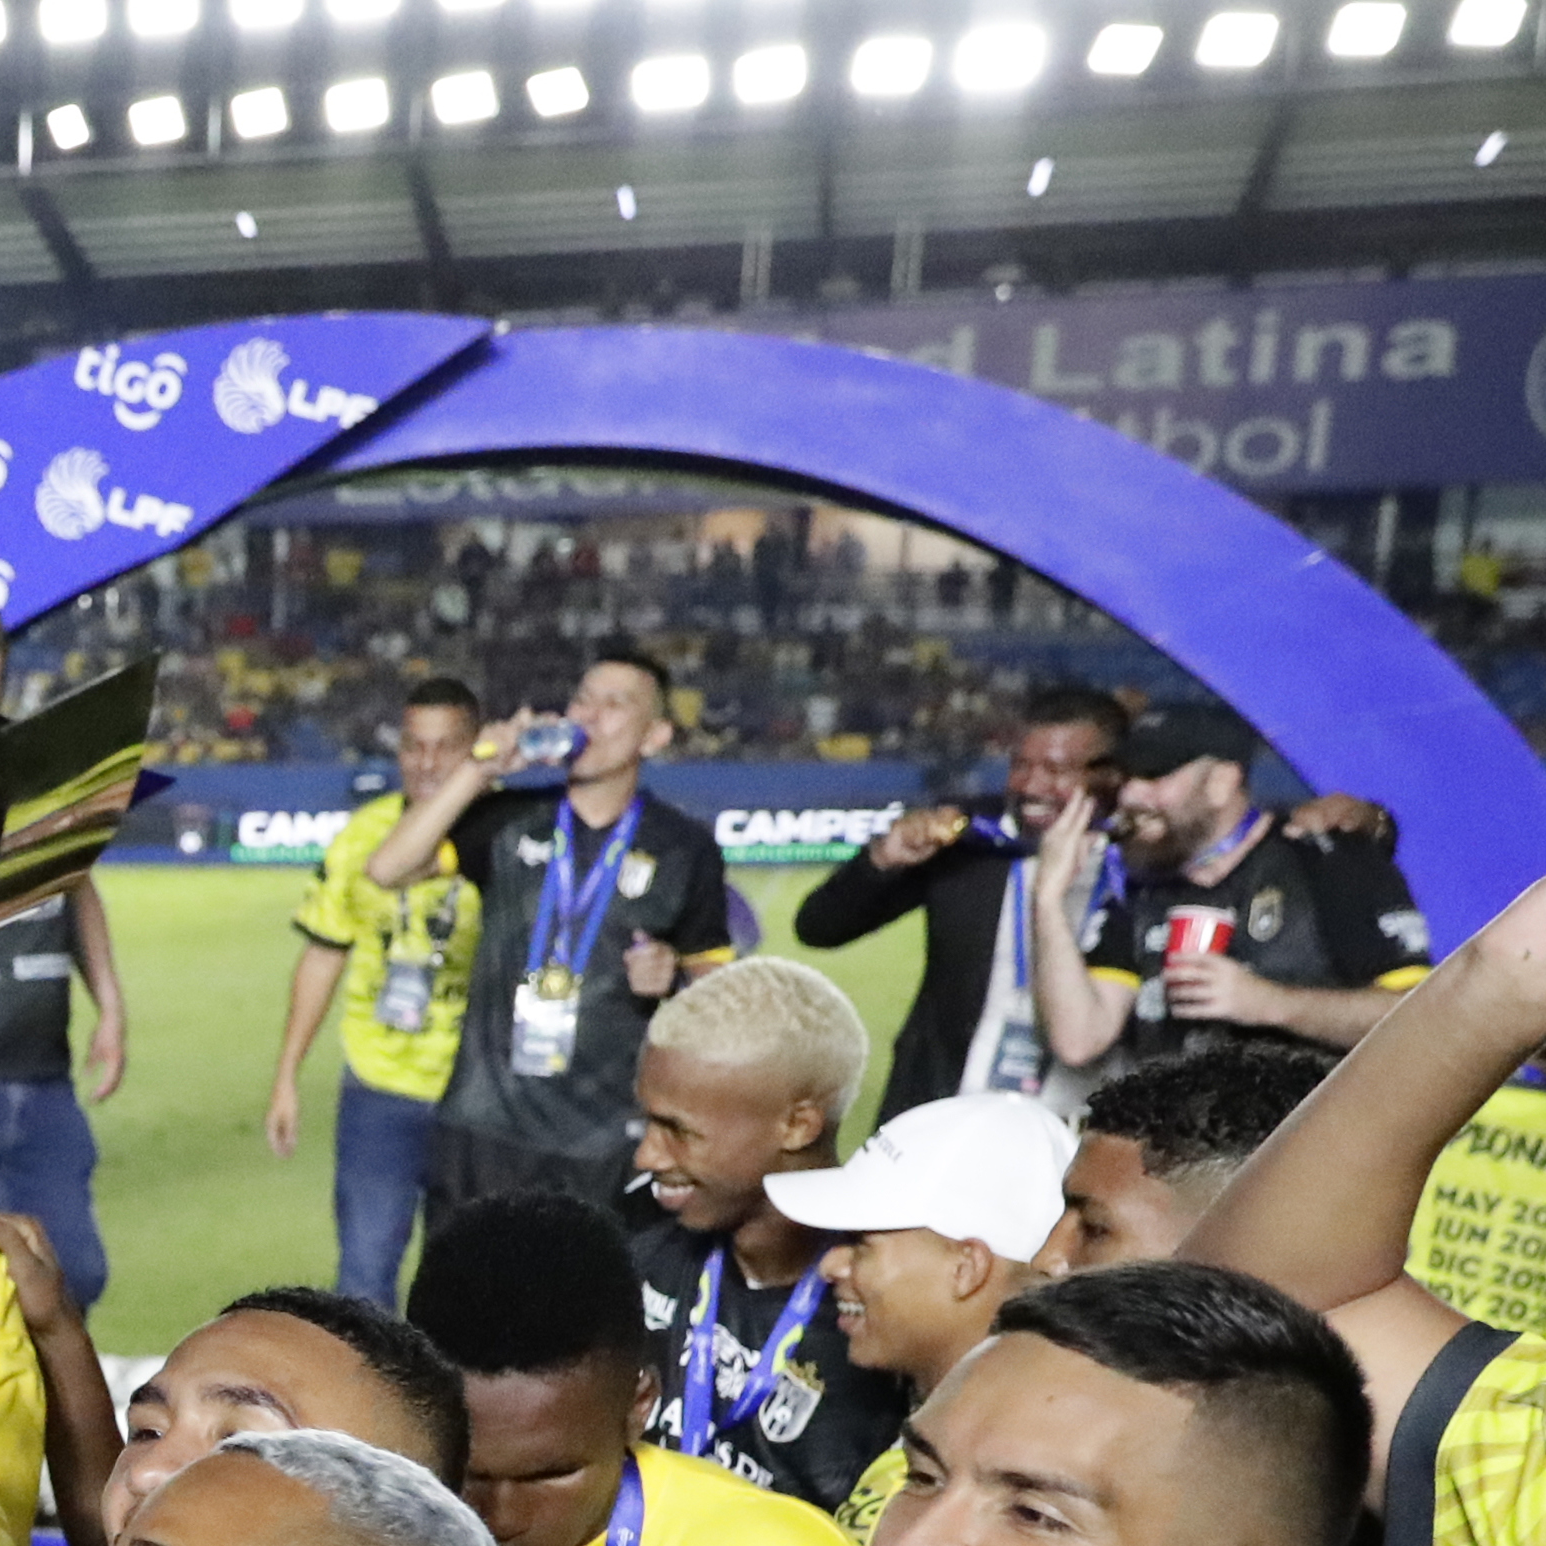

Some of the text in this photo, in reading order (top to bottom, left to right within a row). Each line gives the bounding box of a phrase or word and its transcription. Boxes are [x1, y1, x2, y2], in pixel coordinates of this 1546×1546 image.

[1031, 309, 1459, 396] Latina
[287, 379, 379, 428] LPF
[107, 486, 194, 537] LPF
[714, 801, 904, 846] CAMPE
[1512, 1200, 1546, 1225] 20
[1428, 1247, 1482, 1278] DIC
